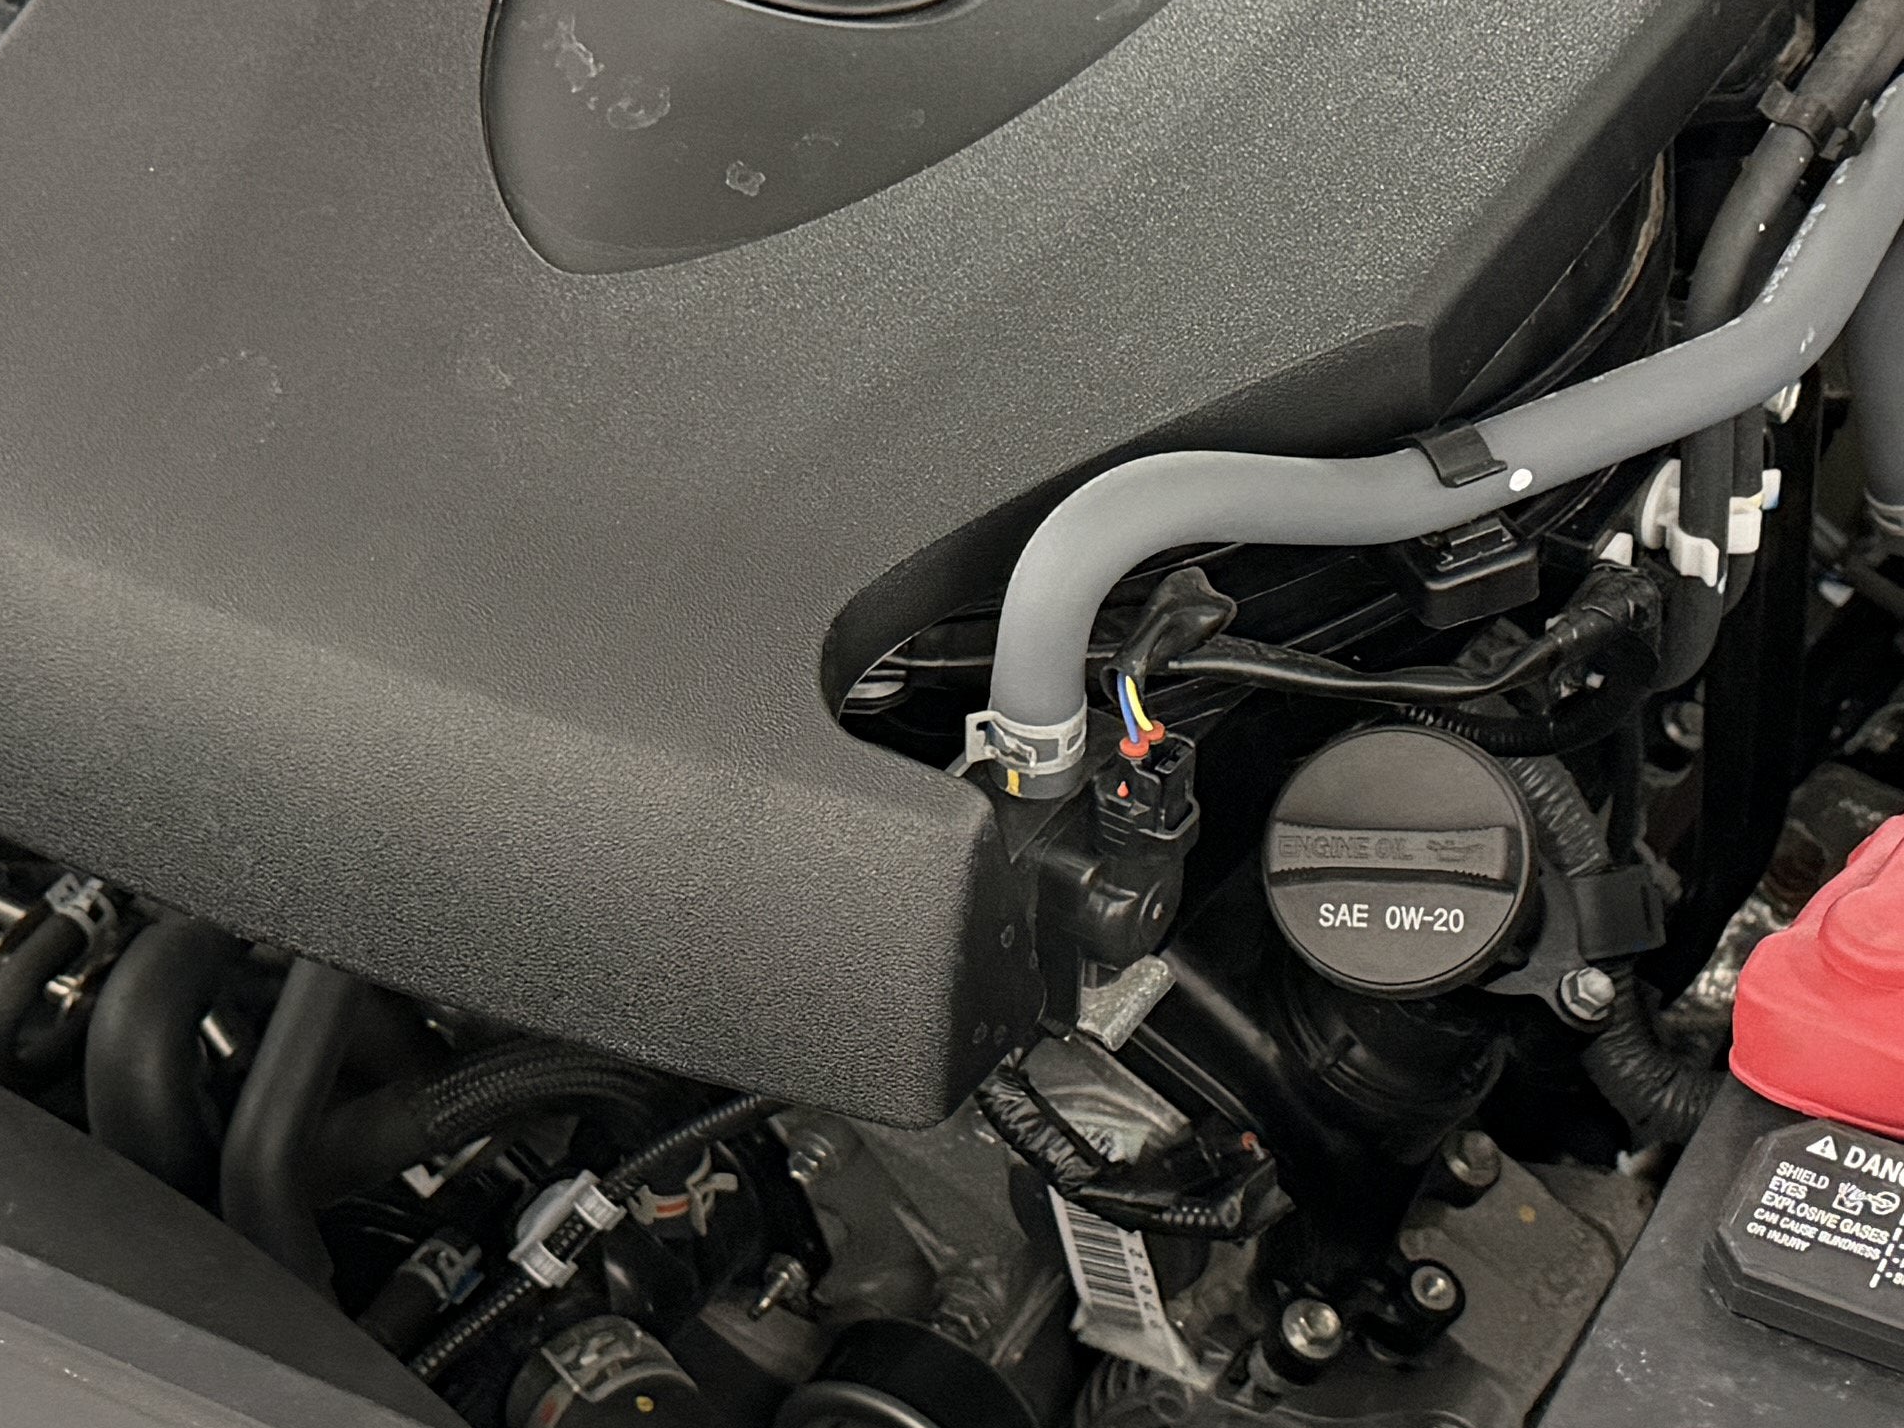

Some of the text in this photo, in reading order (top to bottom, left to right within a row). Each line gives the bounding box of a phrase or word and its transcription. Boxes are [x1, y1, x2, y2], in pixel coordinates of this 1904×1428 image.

[1278, 835, 1370, 859] ENGINE
[1318, 903, 1465, 933] SAE 0W-20
[1768, 1175, 1808, 1200] EYES
[1775, 1161, 1830, 1190] SHIELD
[1760, 1190, 1891, 1246] EXPLOSIVE GASES
